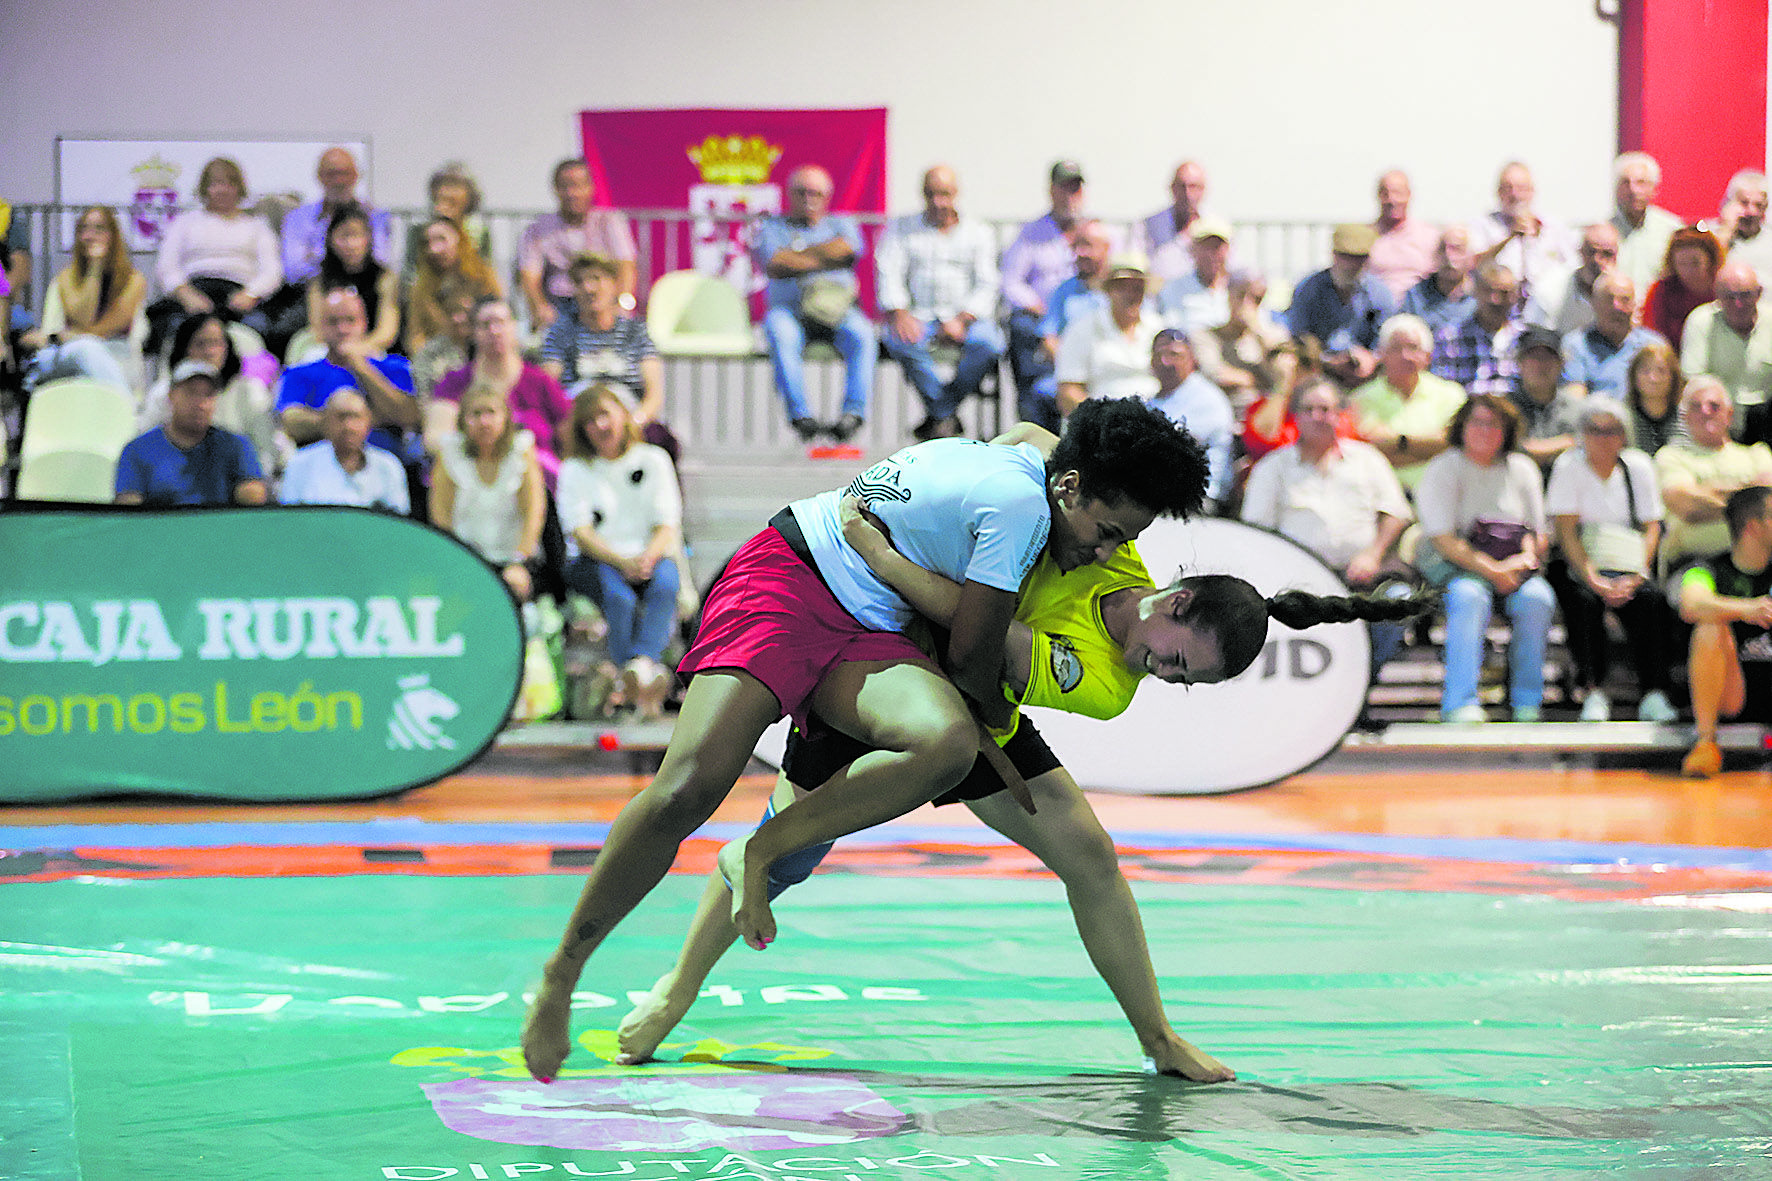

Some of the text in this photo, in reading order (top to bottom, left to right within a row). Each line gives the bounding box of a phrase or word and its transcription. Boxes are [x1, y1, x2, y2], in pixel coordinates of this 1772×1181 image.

[0, 596, 465, 665] CAJA RURAL
[216, 681, 363, 733] León
[380, 1149, 1061, 1181] DIPUTACIÓN
